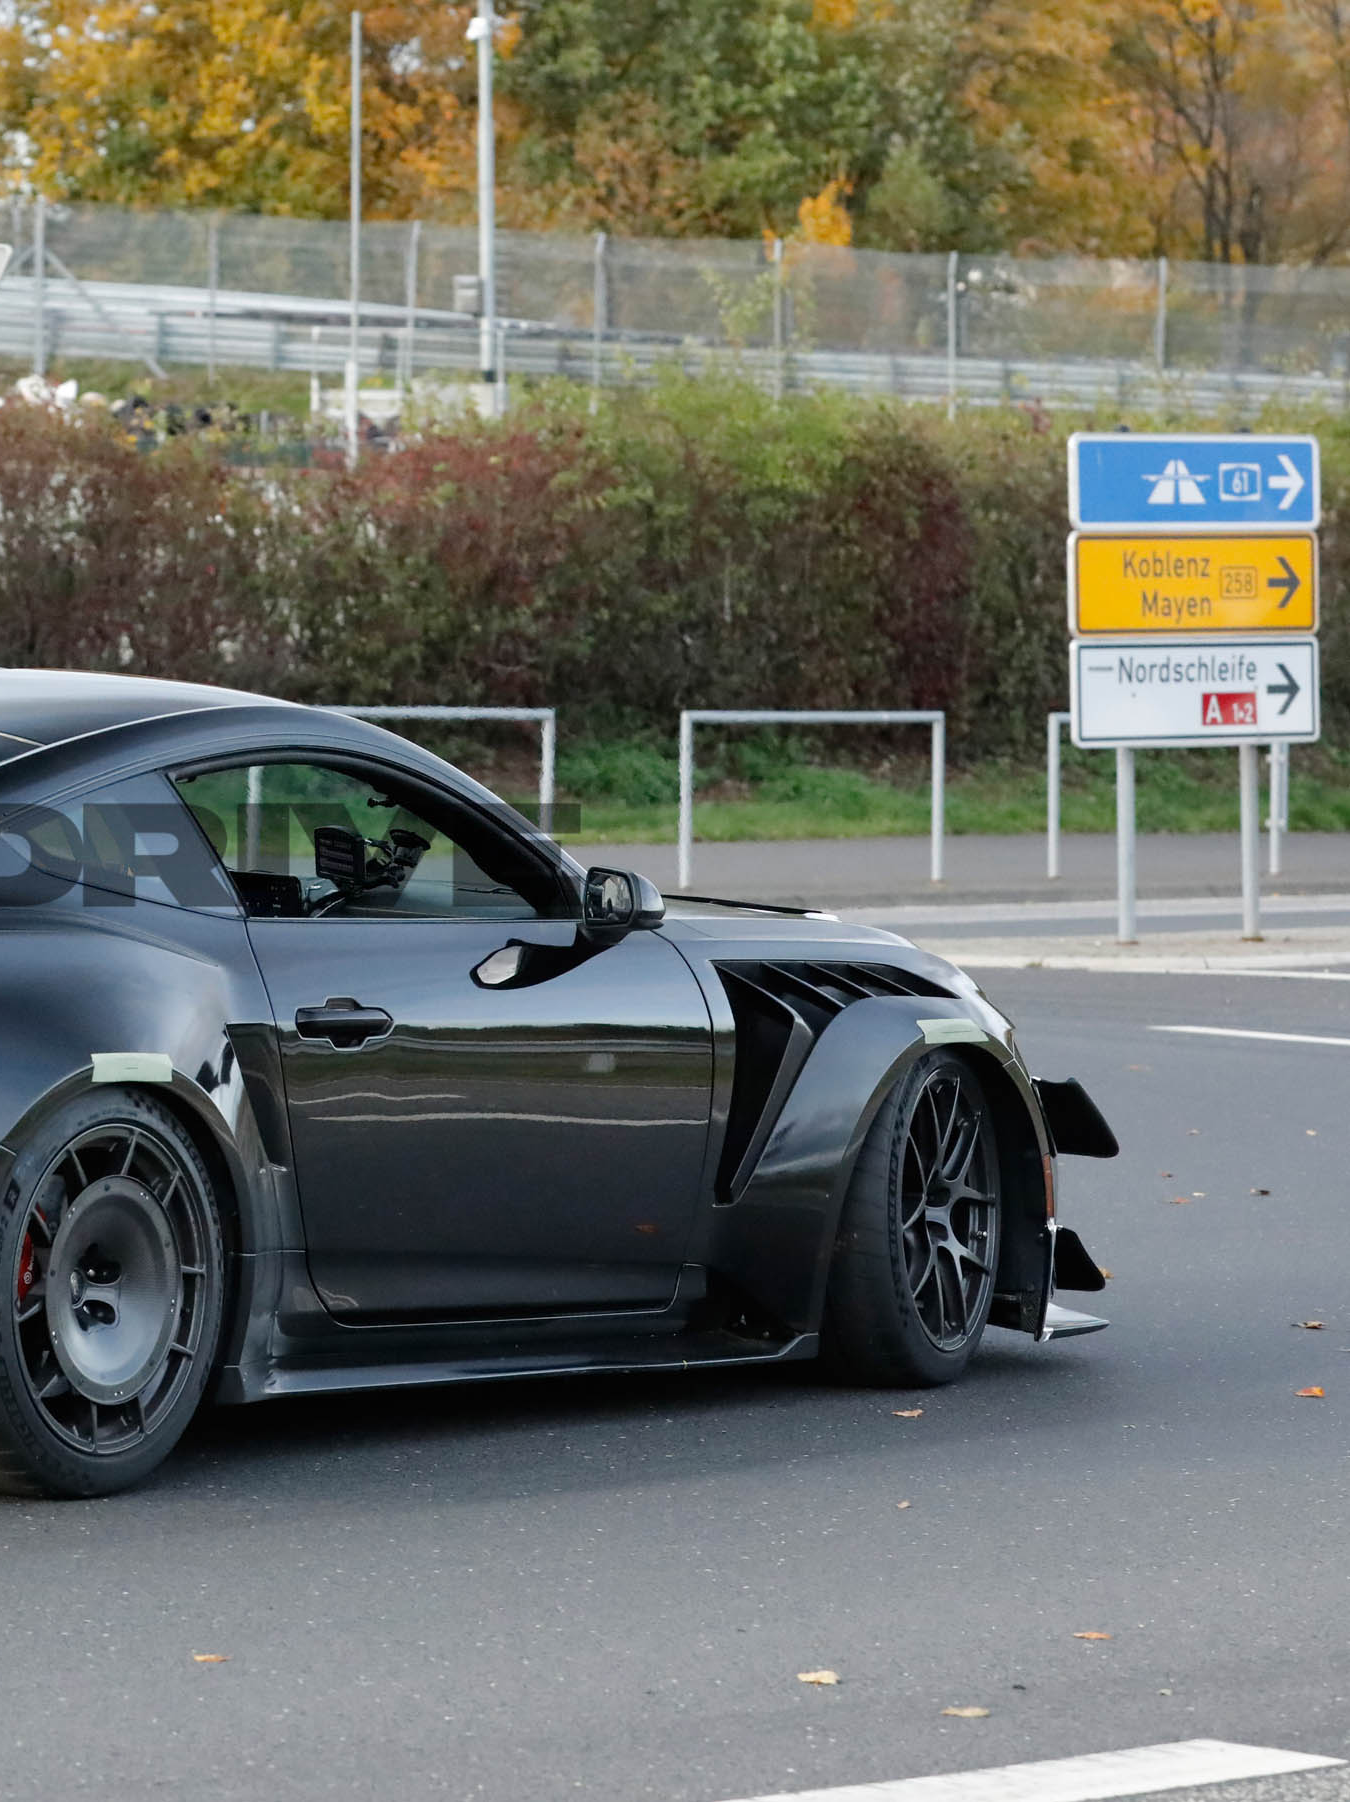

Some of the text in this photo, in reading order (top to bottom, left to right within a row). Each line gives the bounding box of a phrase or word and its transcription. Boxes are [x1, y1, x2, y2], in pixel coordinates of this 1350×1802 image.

[1231, 471, 1251, 494] 61
[1122, 551, 1211, 579] Koblenz
[1224, 573, 1254, 595] 258
[1141, 592, 1212, 624] Mayen
[1118, 656, 1258, 684] Nordschleife
[1205, 695, 1223, 724] A
